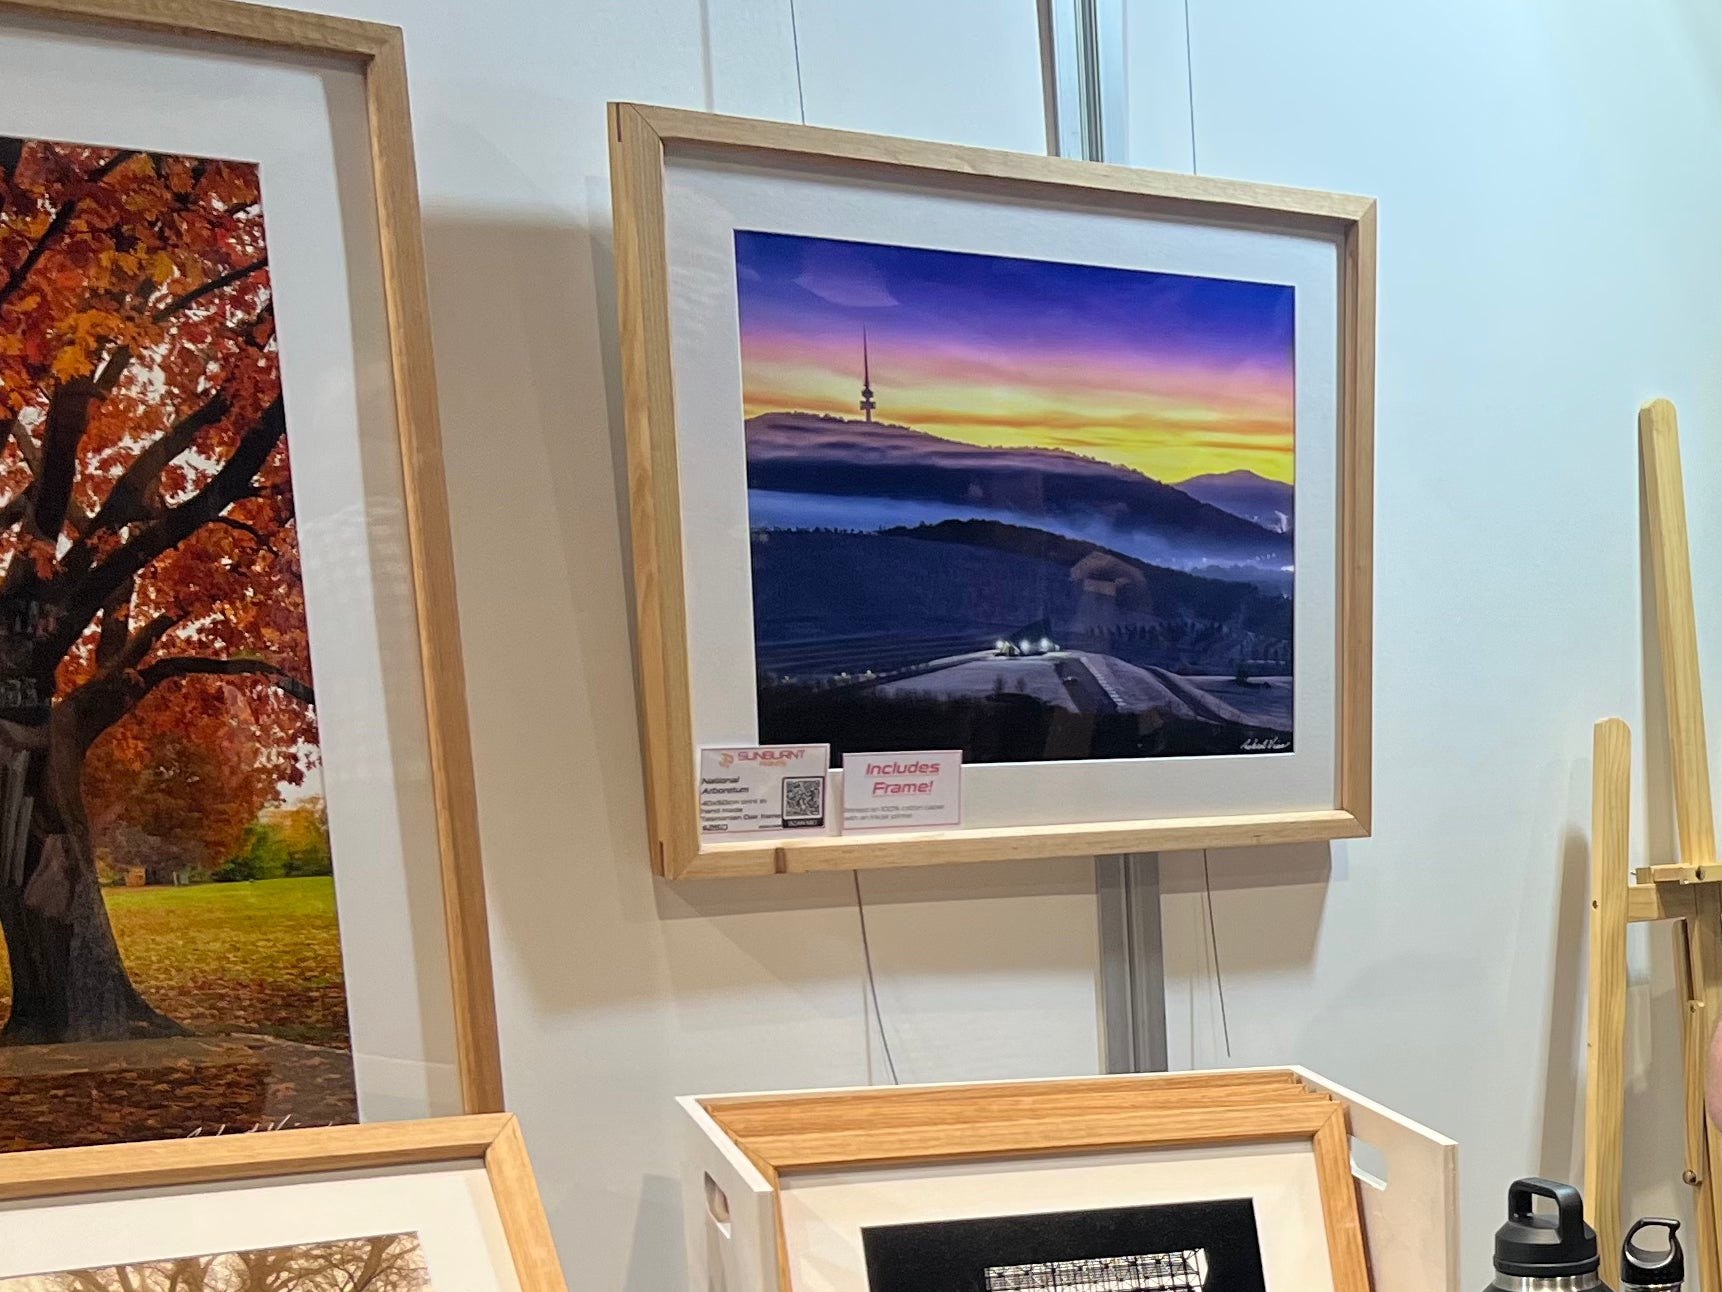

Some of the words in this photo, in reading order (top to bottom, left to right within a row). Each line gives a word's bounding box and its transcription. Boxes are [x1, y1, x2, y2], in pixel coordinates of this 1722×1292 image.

[737, 749, 805, 761] SUNBURNT
[866, 761, 940, 775] Includes
[702, 776, 740, 785] National
[872, 781, 934, 795] Frame!
